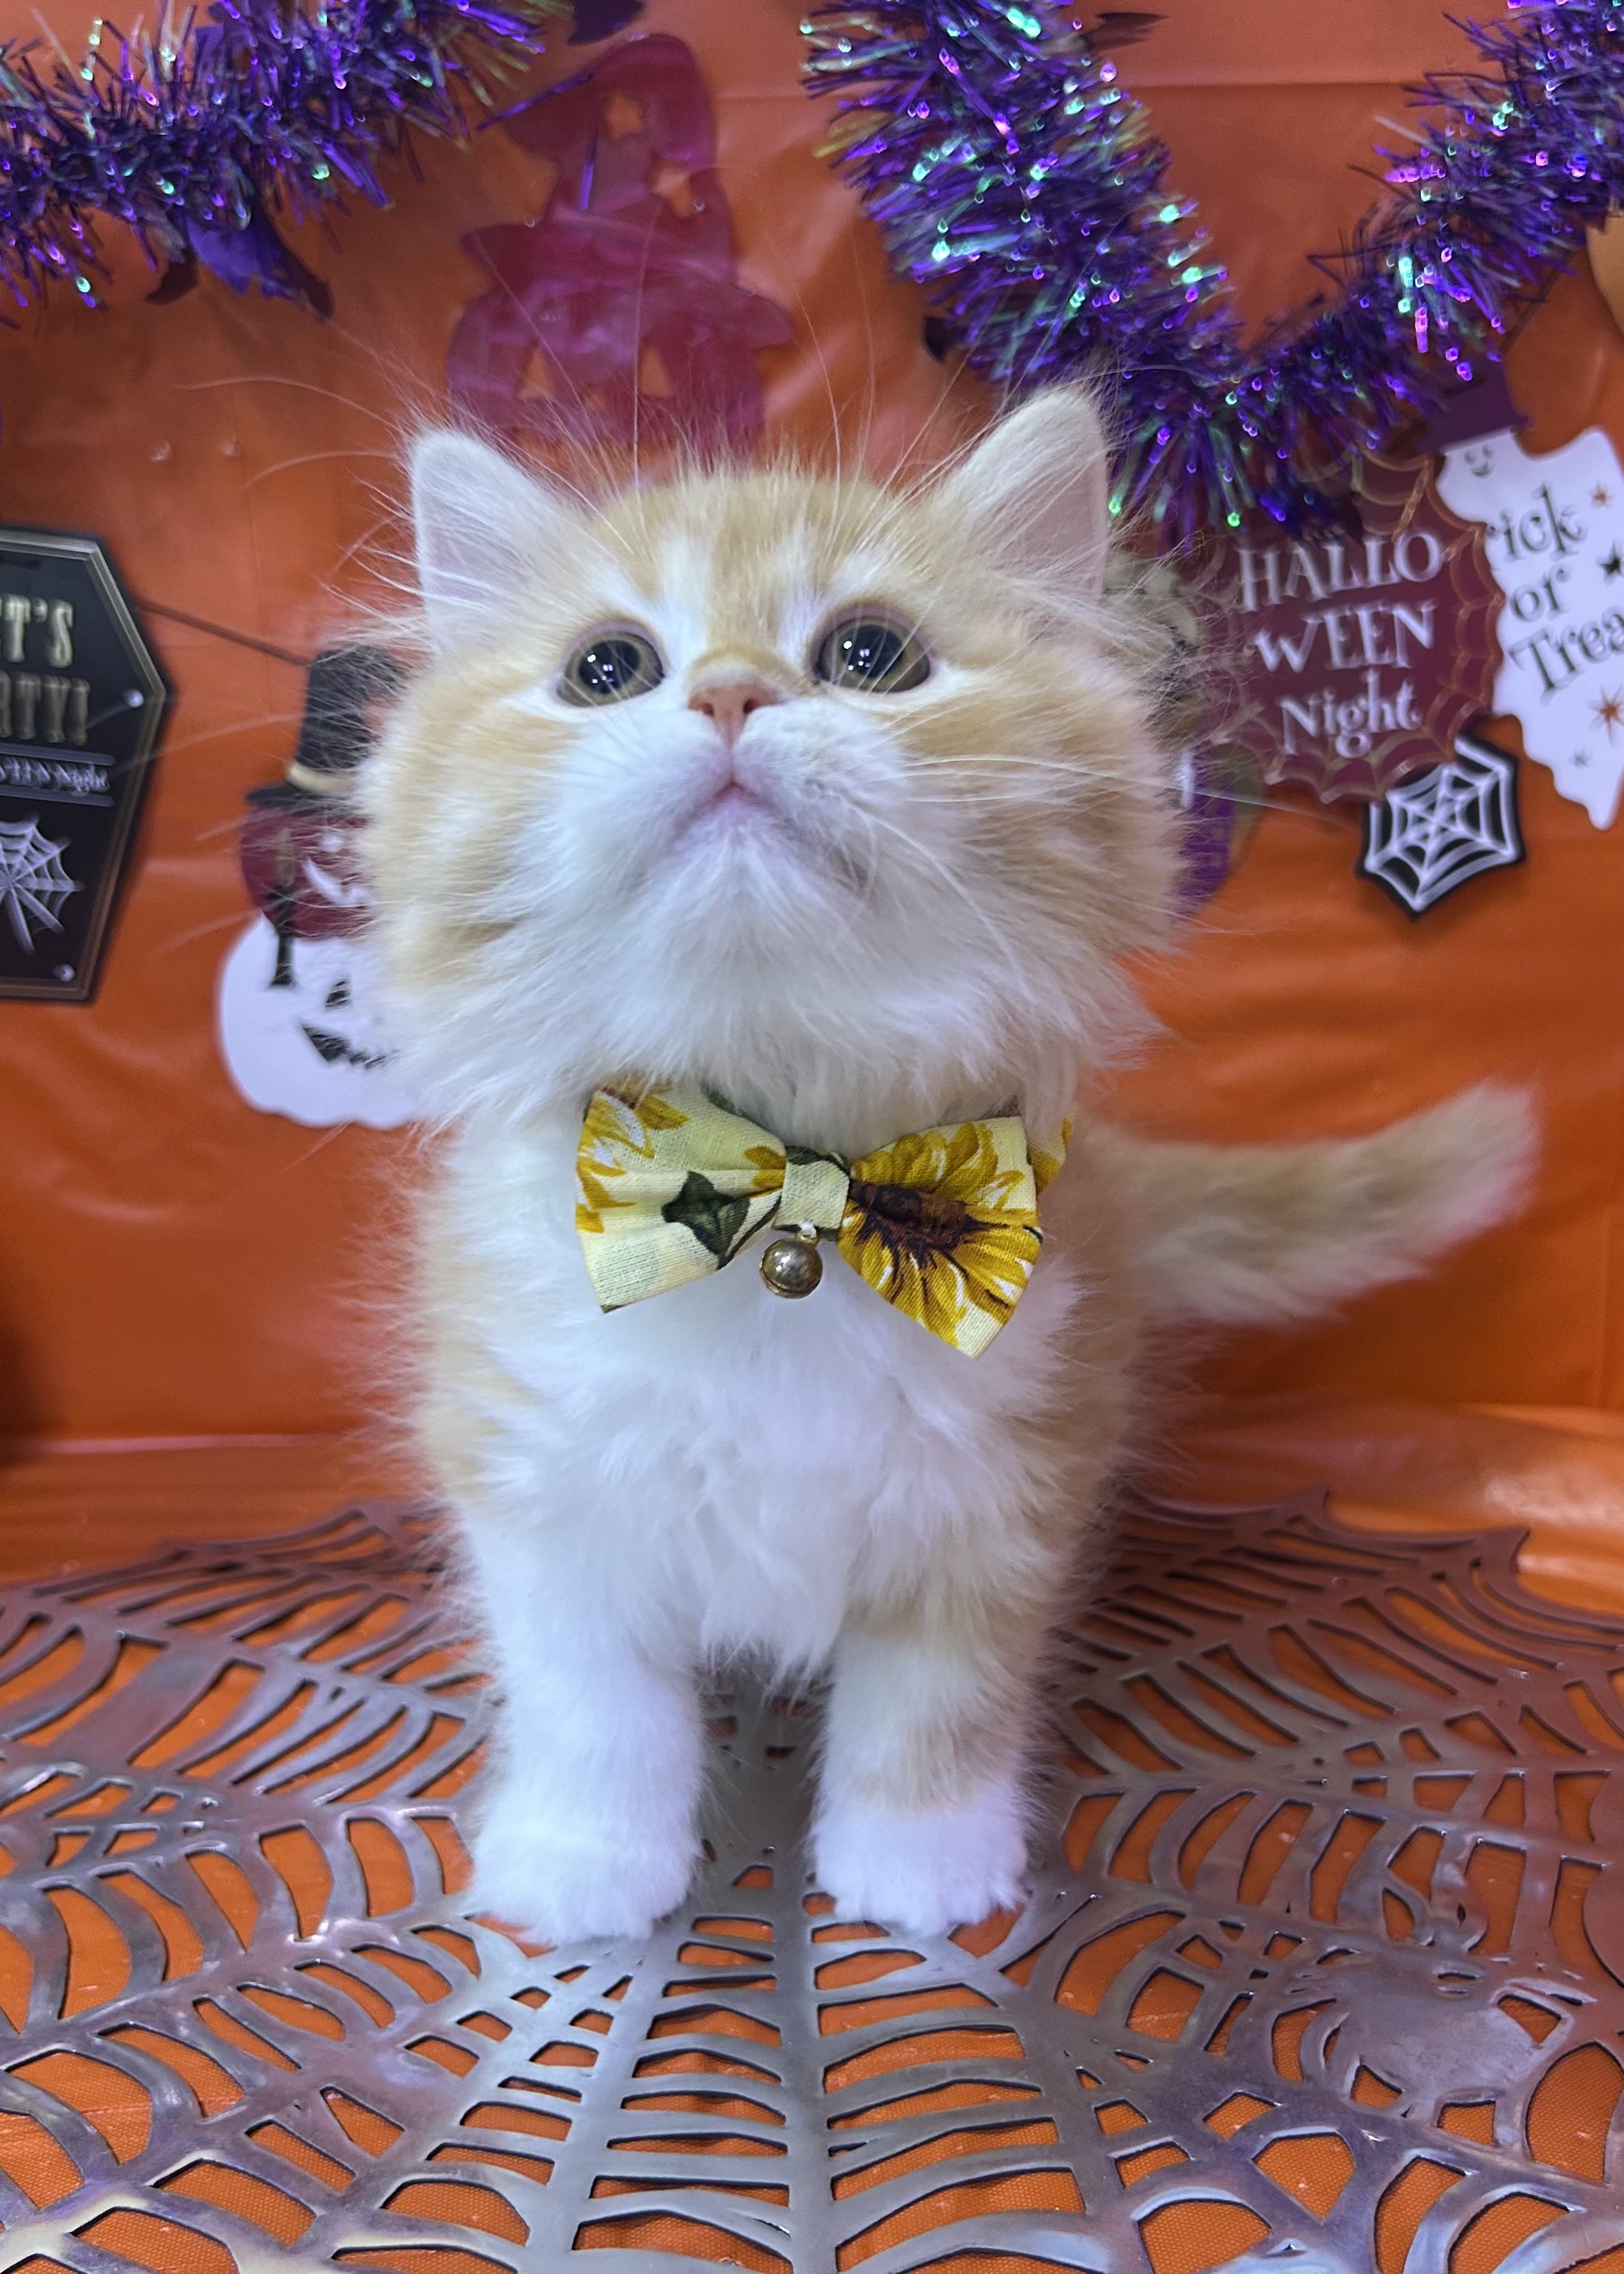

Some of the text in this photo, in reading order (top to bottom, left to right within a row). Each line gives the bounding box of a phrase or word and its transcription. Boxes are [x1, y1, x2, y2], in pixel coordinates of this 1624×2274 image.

[1486, 482, 1587, 562] ick
[1238, 530, 1443, 613] HALLO
[1510, 564, 1570, 622] or
[1254, 600, 1437, 674] WEEN
[1280, 669, 1421, 759] Night
